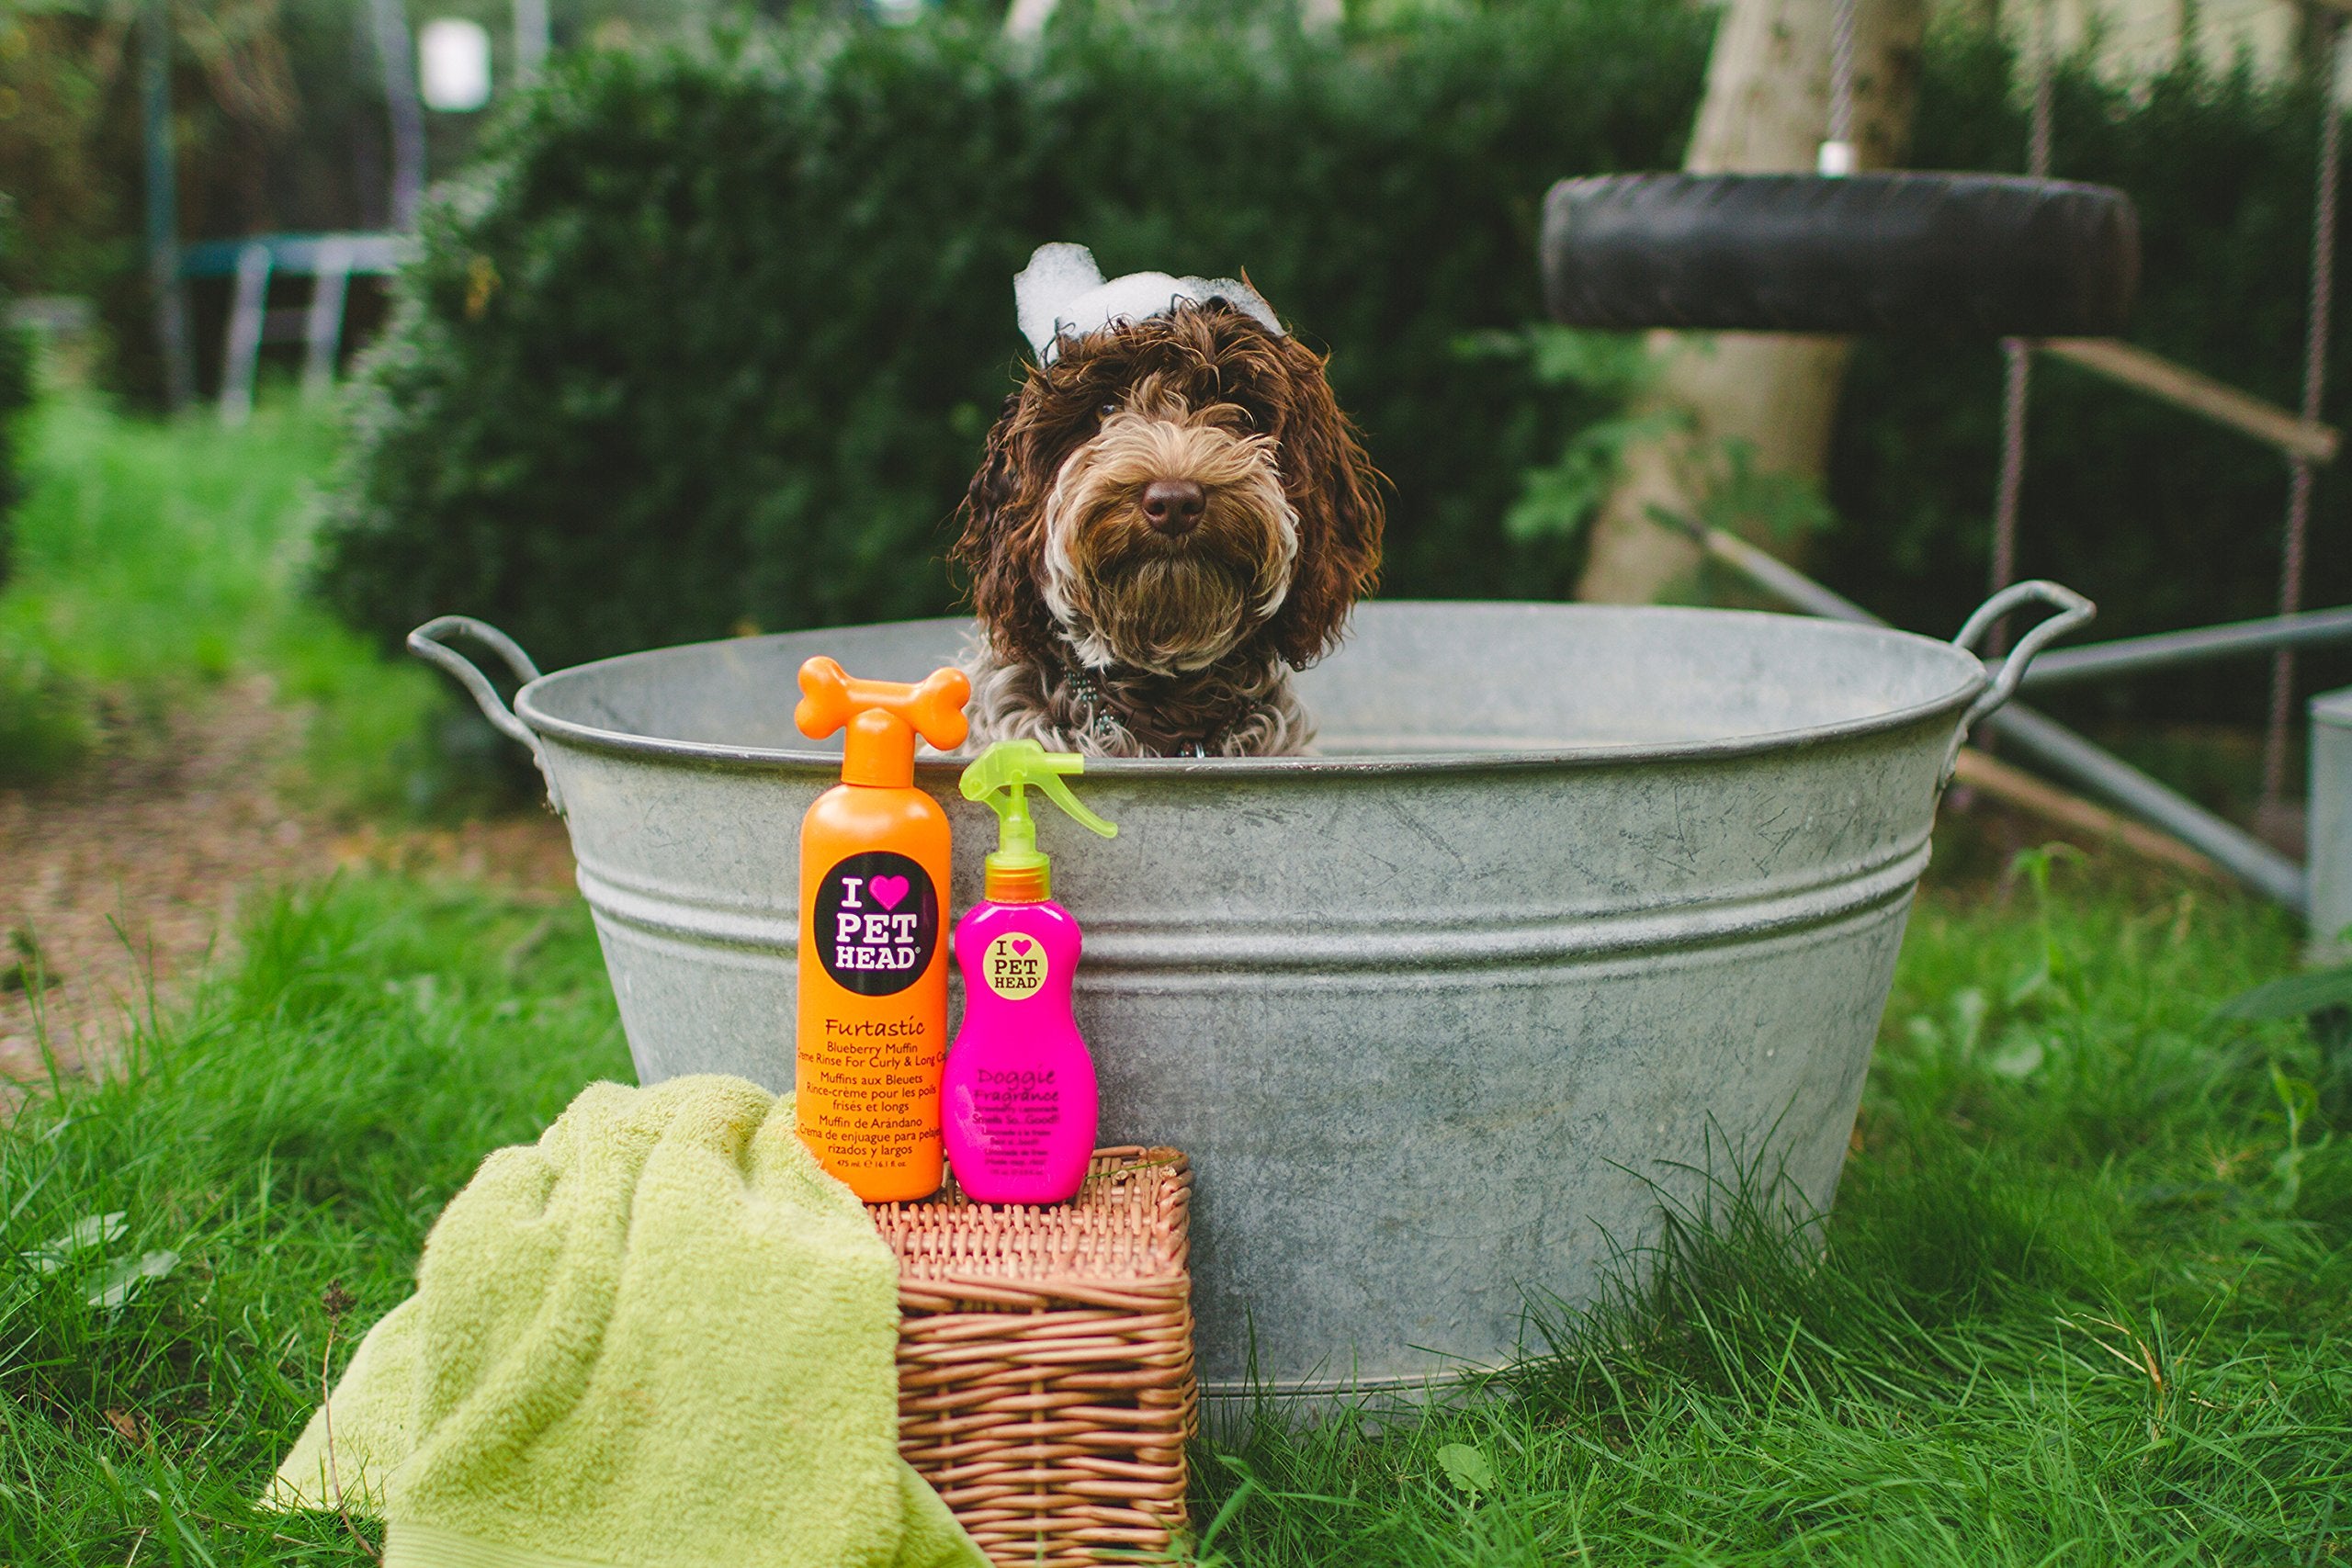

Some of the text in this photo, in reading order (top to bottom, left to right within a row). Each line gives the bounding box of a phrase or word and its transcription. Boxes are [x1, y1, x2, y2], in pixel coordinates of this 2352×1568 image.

[842, 877, 864, 908] I
[836, 913, 917, 943] PET
[996, 941, 1007, 955] I
[995, 960, 1038, 975] PET
[825, 1015, 925, 1036] Furtastic
[827, 1041, 918, 1058] Blueberry Muffin
[816, 1053, 842, 1066] Rinse
[845, 1056, 865, 1067] For
[869, 1055, 901, 1070] Curly
[904, 1056, 912, 1066] &
[915, 1053, 935, 1067] Long
[820, 1072, 923, 1086] Muffins aux Bleuets
[978, 1064, 1056, 1090] Doggie
[807, 1082, 937, 1101] Rince-crème pour les poils
[974, 1089, 1059, 1106] Fragrance
[832, 1100, 910, 1114] frisés et longs
[819, 1114, 923, 1129] Muffin de Arándano
[799, 1122, 942, 1145] Crema de enjuague para pelaje
[828, 1144, 912, 1159] rizados y largos
[837, 1159, 850, 1168] 475
